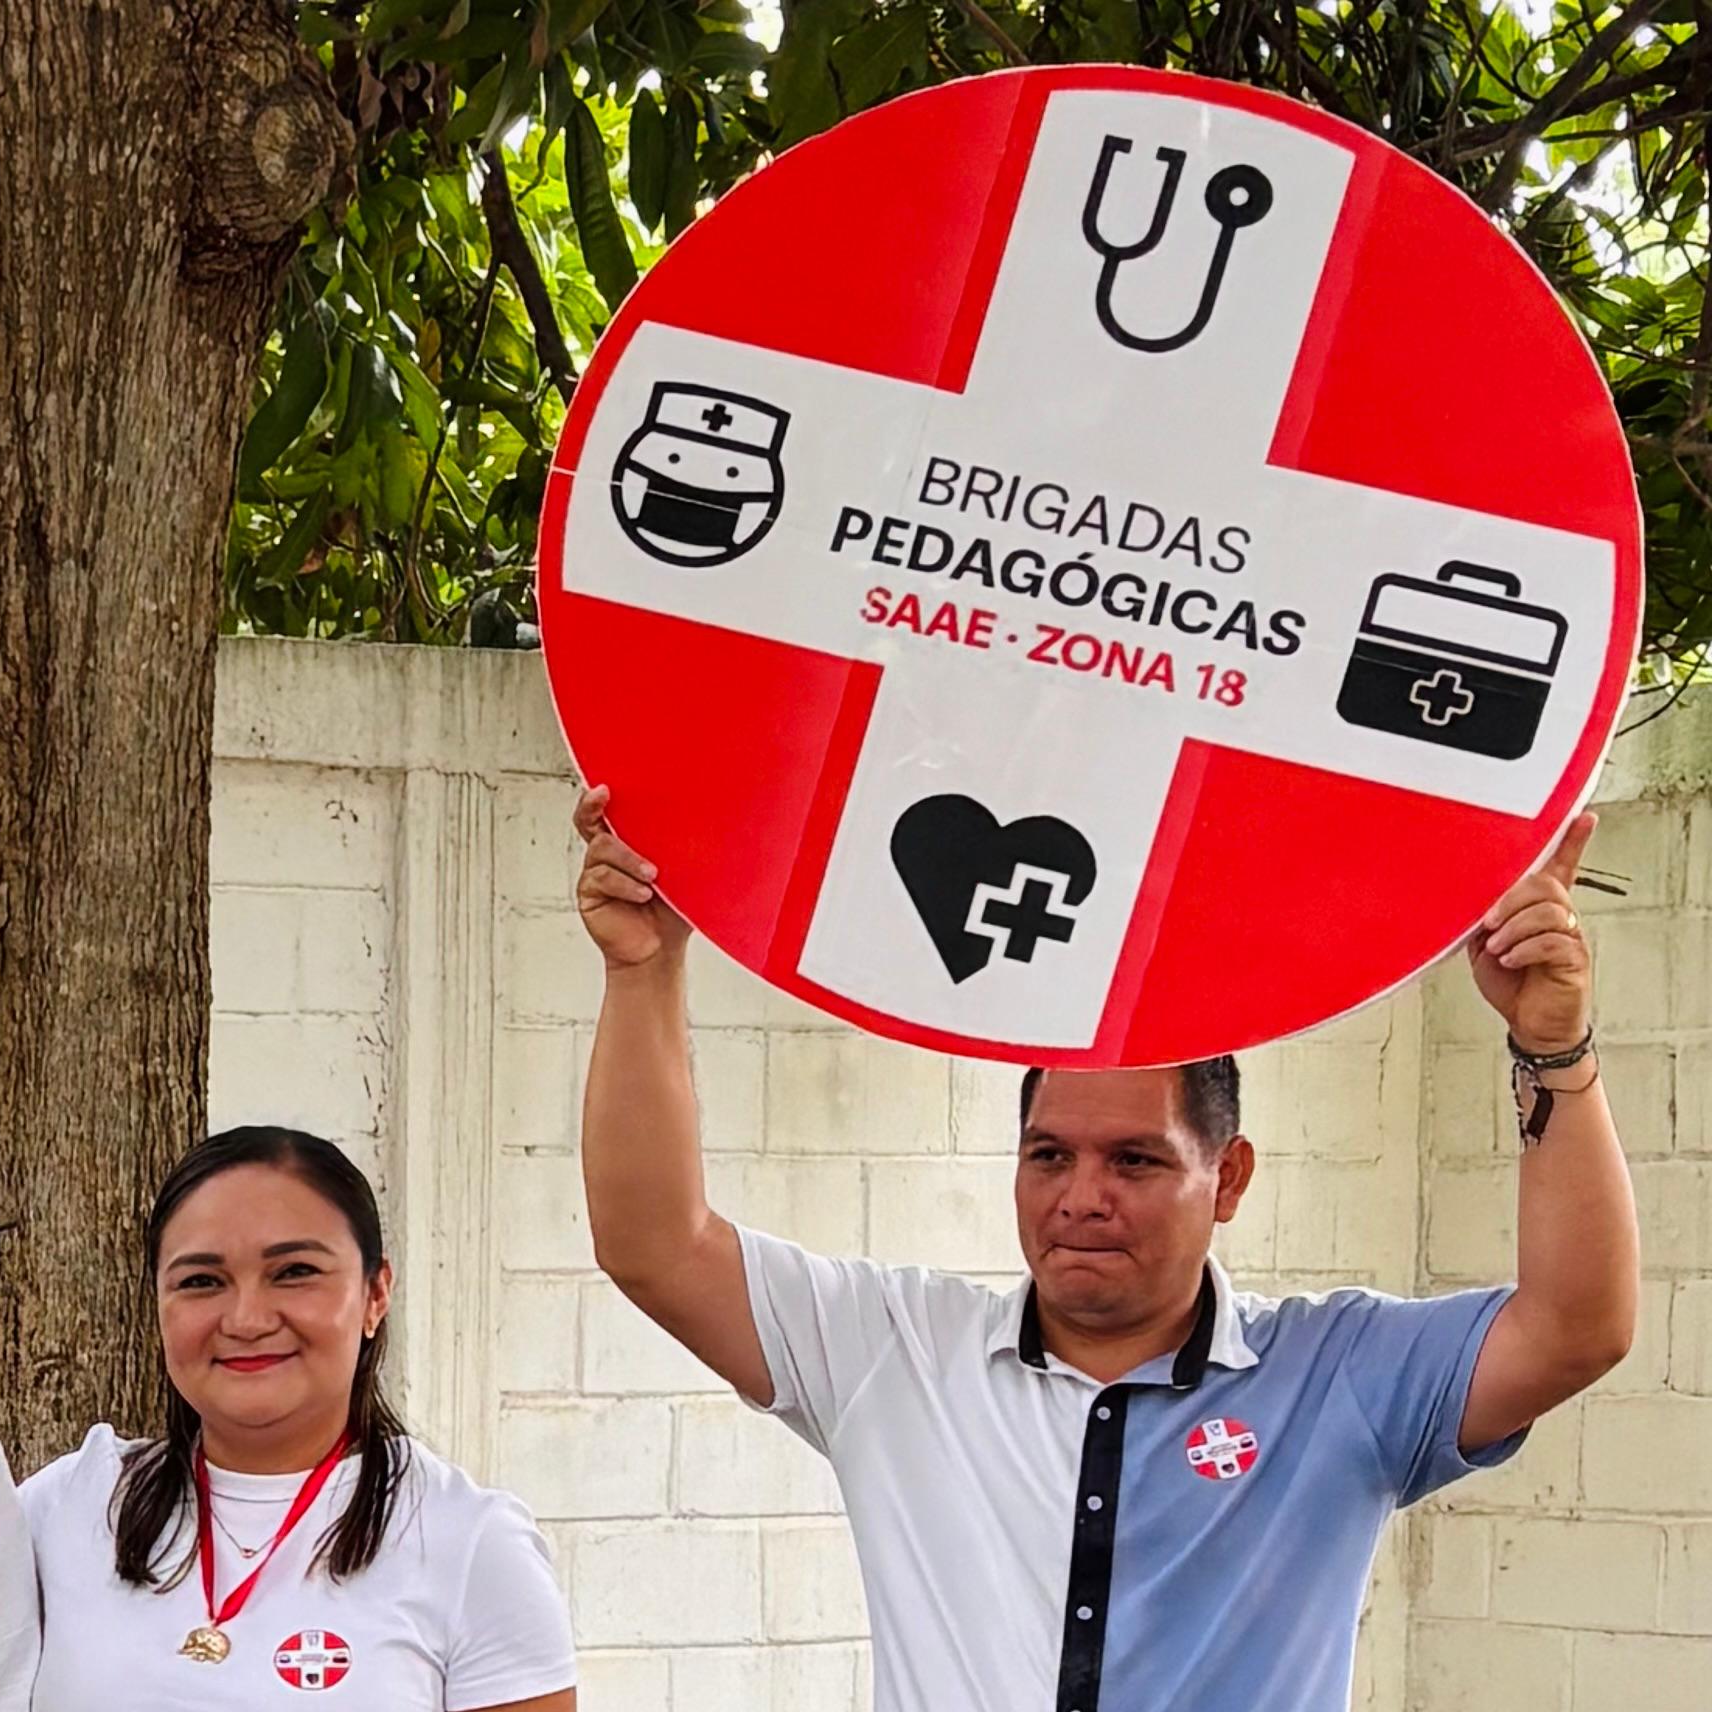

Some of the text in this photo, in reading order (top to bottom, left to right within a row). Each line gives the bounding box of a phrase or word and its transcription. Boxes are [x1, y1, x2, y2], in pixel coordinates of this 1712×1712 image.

[918, 456, 1251, 574] BRIGADAS
[829, 506, 1306, 656] PEDAGÓGICAS
[860, 586, 998, 648] SAAE
[1027, 623, 1176, 692] ZONA
[1196, 663, 1248, 707] 18
